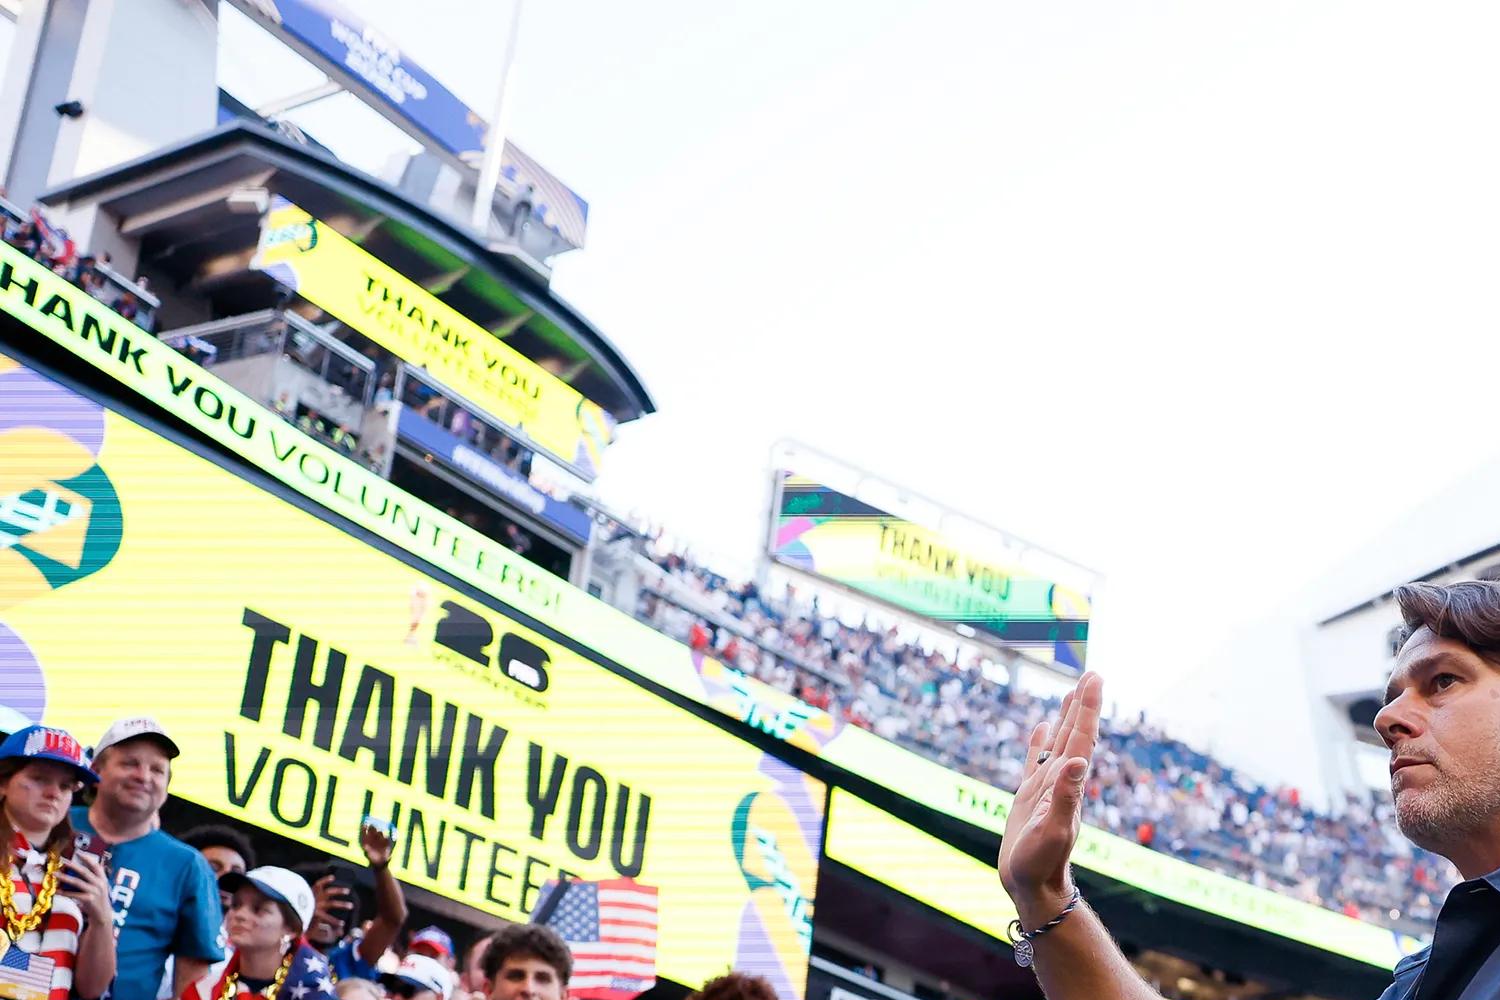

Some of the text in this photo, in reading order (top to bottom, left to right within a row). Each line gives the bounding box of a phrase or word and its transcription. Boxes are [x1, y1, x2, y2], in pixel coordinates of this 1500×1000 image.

[365, 273, 540, 400] THANK YOU
[167, 365, 256, 440] YOU
[270, 430, 561, 612] VOLUNTEERS!
[879, 522, 959, 579] THANK
[966, 559, 1011, 601] YOU
[434, 600, 552, 692] 26
[44, 731, 82, 761] USA
[240, 607, 651, 878] THANK YOU
[224, 731, 581, 914] VOLUNTEE
[956, 785, 1008, 819] THA
